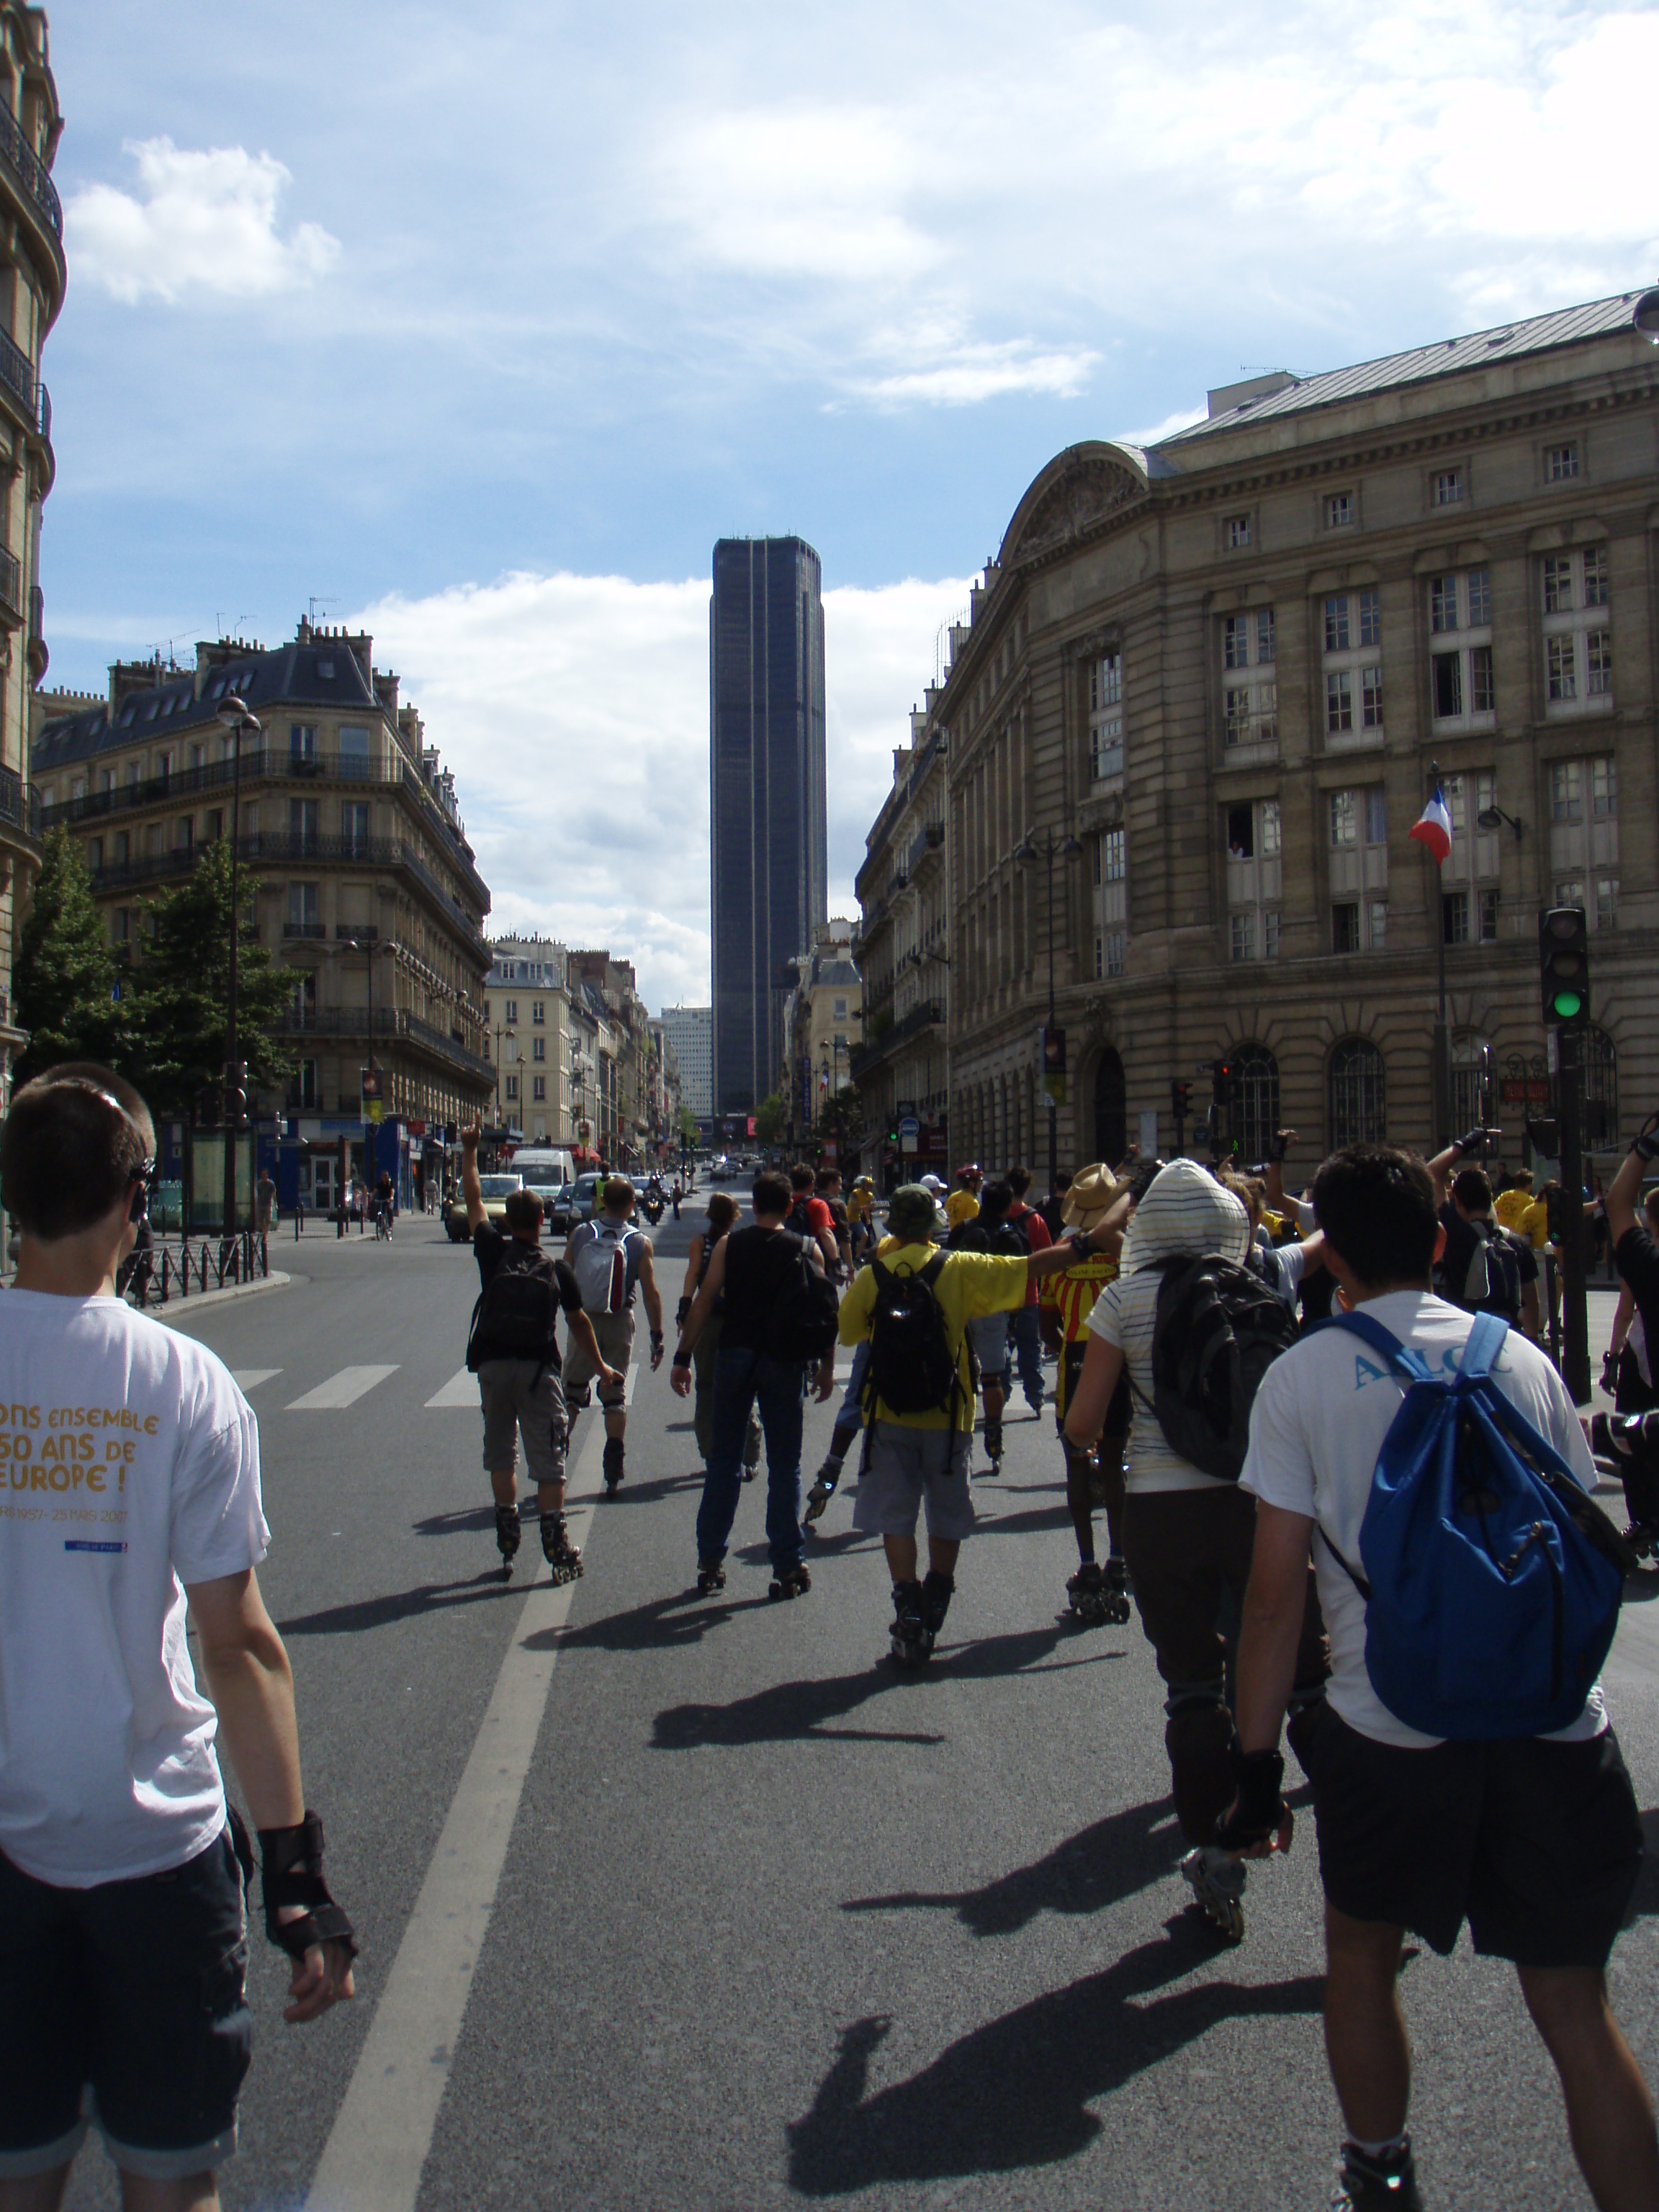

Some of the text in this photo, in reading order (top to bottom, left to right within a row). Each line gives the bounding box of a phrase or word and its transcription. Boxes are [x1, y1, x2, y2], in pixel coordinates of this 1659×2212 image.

[48, 1407, 160, 1435] ENSEMBLE
[41, 1433, 95, 1462] ANS
[106, 1440, 137, 1463] DE
[53, 1509, 68, 1521] 25
